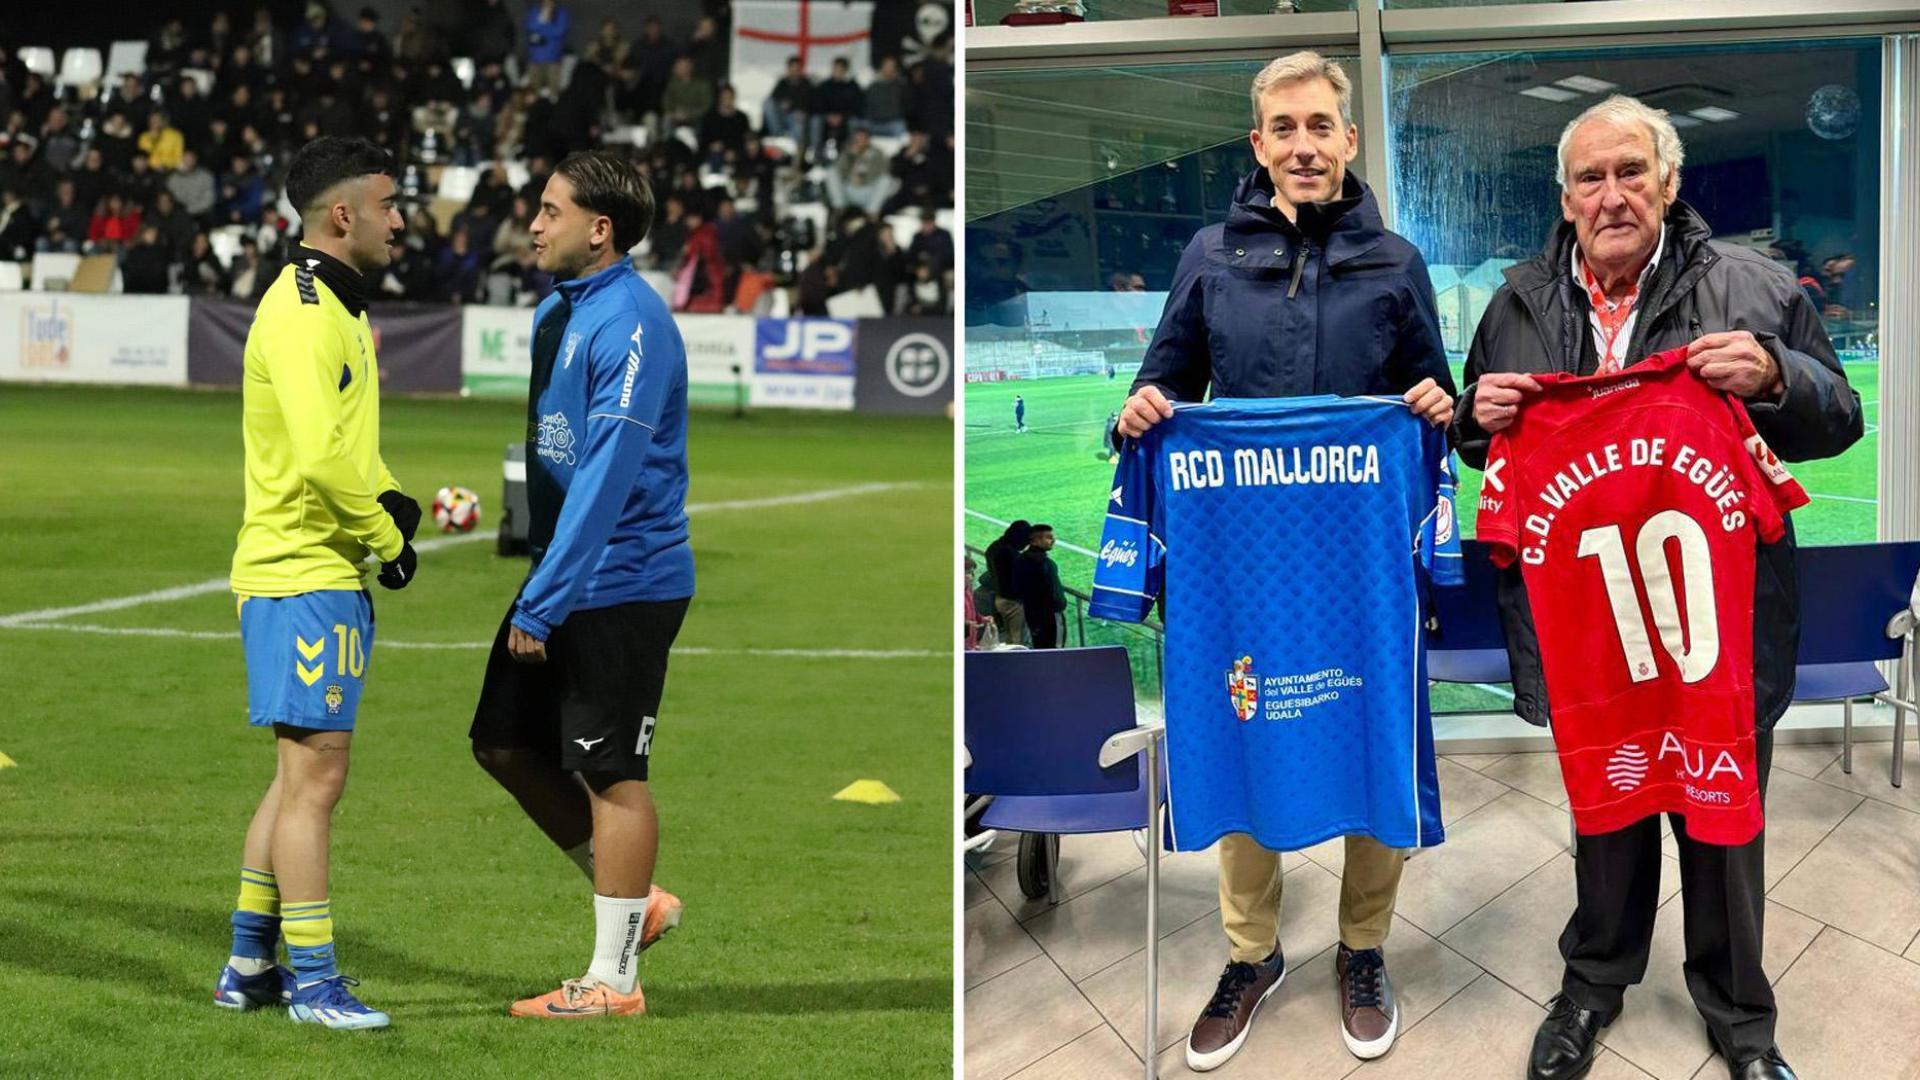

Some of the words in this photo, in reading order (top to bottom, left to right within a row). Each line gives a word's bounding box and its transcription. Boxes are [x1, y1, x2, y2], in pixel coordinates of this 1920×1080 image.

[763, 320, 853, 361] JP
[1169, 451, 1224, 491] RCD
[1233, 445, 1380, 487] MALLORCA
[1539, 443, 1623, 510] VALLE
[1631, 438, 1666, 466] DE
[1671, 444, 1746, 532] EGÜÉS
[1577, 509, 1720, 684] 10
[333, 624, 364, 677] 10
[1264, 668, 1343, 687] AYUNTAMIENTO
[1264, 688, 1279, 697] del
[1280, 684, 1314, 696] VALLE
[1315, 681, 1326, 691] de
[1327, 675, 1363, 688] EGÜÉS
[1265, 691, 1339, 710] EGUESIBARKO
[1265, 709, 1302, 721] UDALA
[1658, 731, 1743, 780] AUA
[1686, 783, 1731, 804] RESORTS
